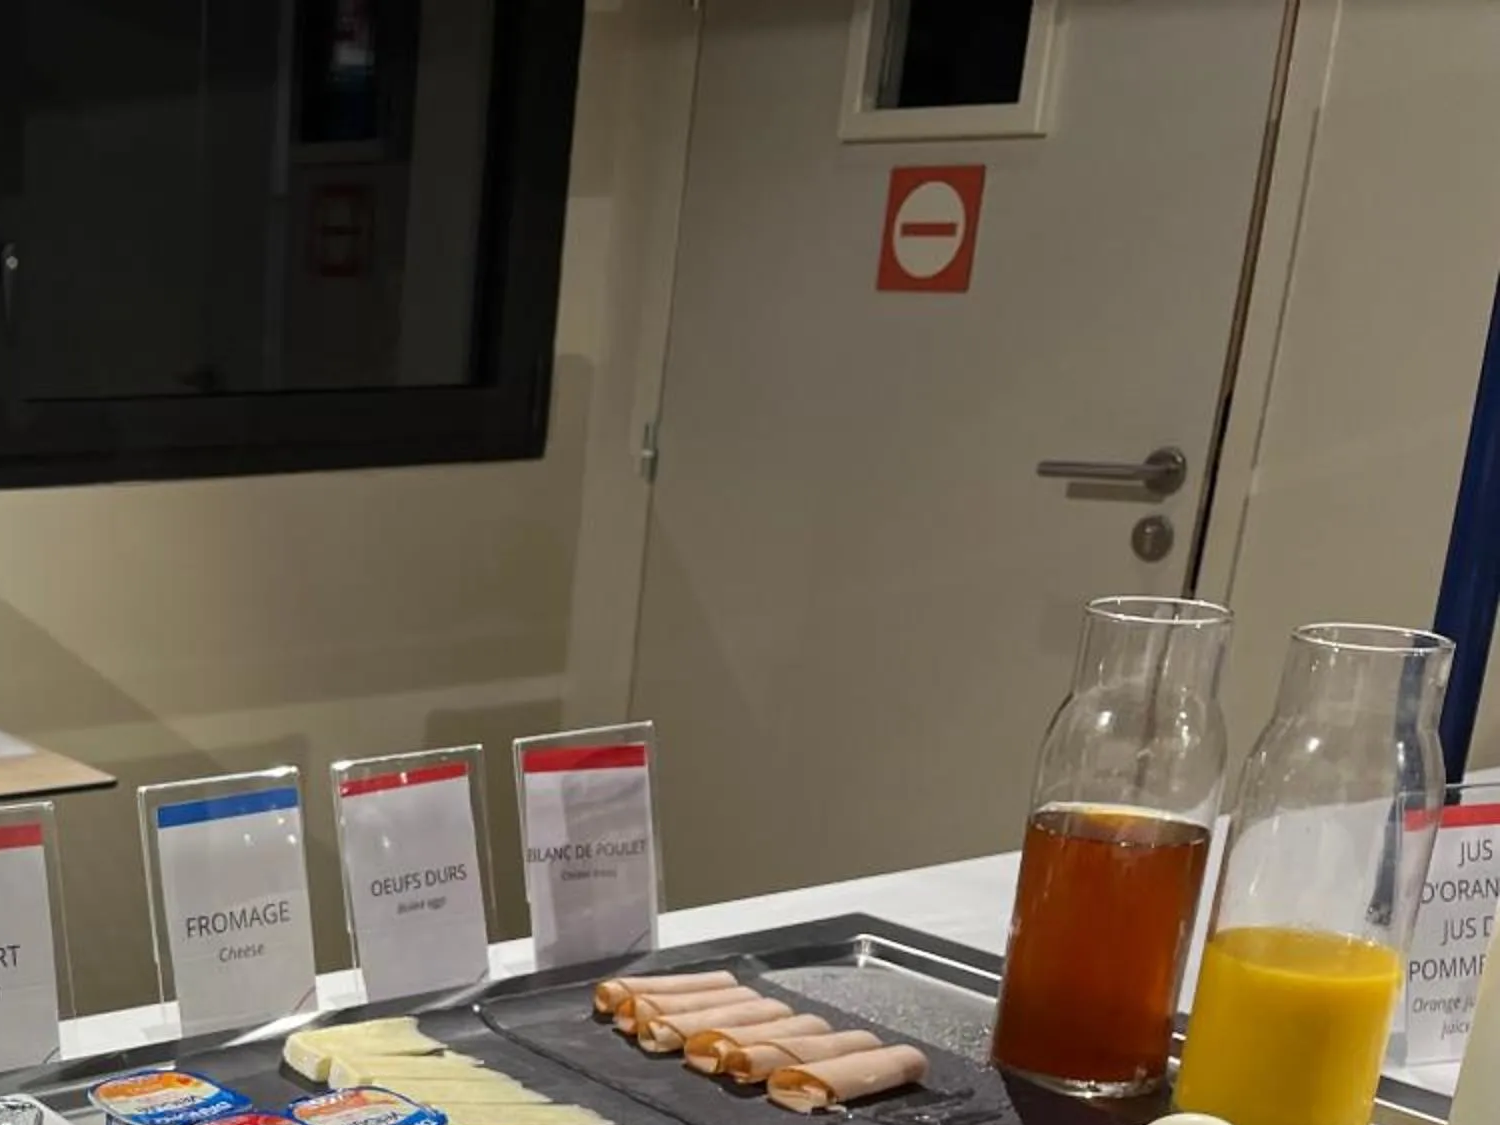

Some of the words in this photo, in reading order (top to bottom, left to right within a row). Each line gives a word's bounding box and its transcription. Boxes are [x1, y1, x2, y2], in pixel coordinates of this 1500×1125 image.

[1458, 839, 1493, 868] JUS
[371, 872, 422, 896] OEUFS
[425, 864, 467, 887] DURS
[185, 901, 291, 939] FROMAGE
[1440, 917, 1477, 946] JUS
